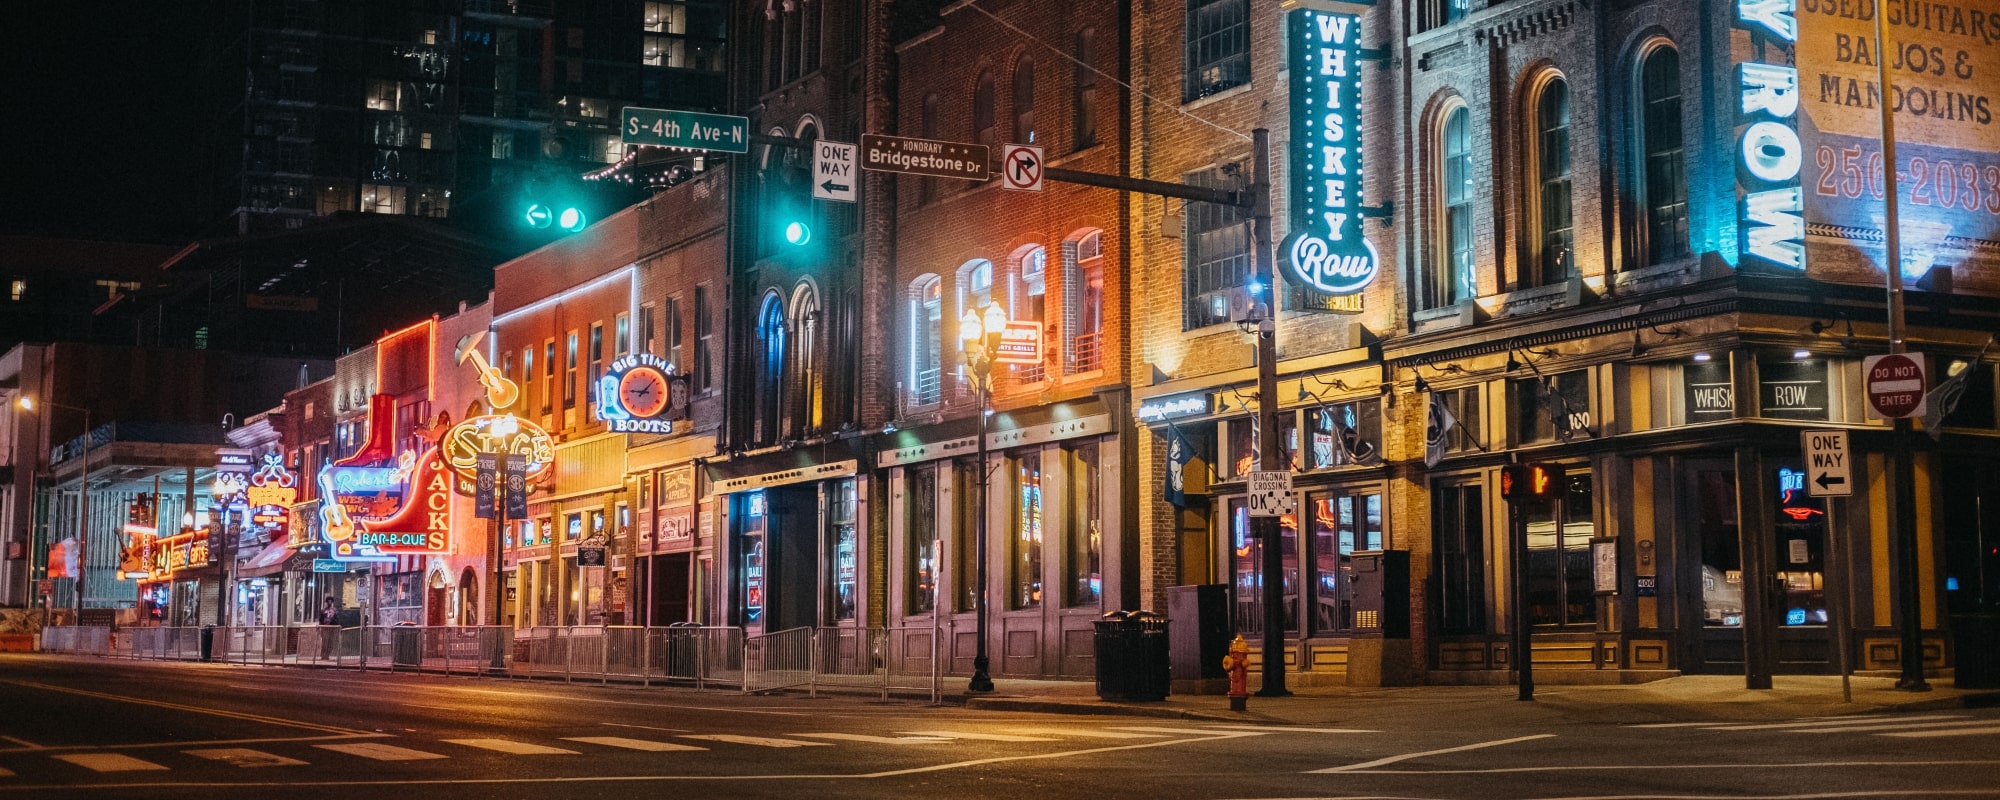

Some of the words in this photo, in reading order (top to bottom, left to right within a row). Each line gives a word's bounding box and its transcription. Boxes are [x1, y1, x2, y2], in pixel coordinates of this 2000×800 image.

[1836, 33, 1946, 76] BAJOS
[1954, 50, 1973, 80] &
[1315, 15, 1350, 241] WHISKEY
[821, 145, 850, 162] ONE
[903, 140, 942, 154] HONORARY
[820, 160, 850, 178] WAY
[869, 149, 963, 173] Bridgestone
[966, 160, 981, 173] Dr
[1740, 62, 1807, 270] ROW
[1299, 236, 1371, 284] Row
[1306, 289, 1364, 311] NASHVILLE
[612, 355, 637, 373] BIG
[641, 353, 675, 375] TIME
[1874, 368, 1889, 379] DO
[1895, 365, 1916, 377] NOT
[1694, 387, 1733, 408] WHISK
[1775, 386, 1807, 406] ROW
[1880, 394, 1913, 406] ENTER
[615, 420, 671, 432] BOOTS
[452, 424, 554, 469] STGE
[1812, 436, 1842, 450] ONE
[478, 462, 496, 470] FANS
[1813, 453, 1843, 468] WAY
[1253, 472, 1288, 482] DIAGONAL
[1253, 481, 1288, 491] CROSSING
[427, 460, 449, 550] JACKS
[1250, 493, 1268, 510] OK
[362, 533, 427, 545] BAR-B-QUE
[1638, 579, 1654, 587] 400
